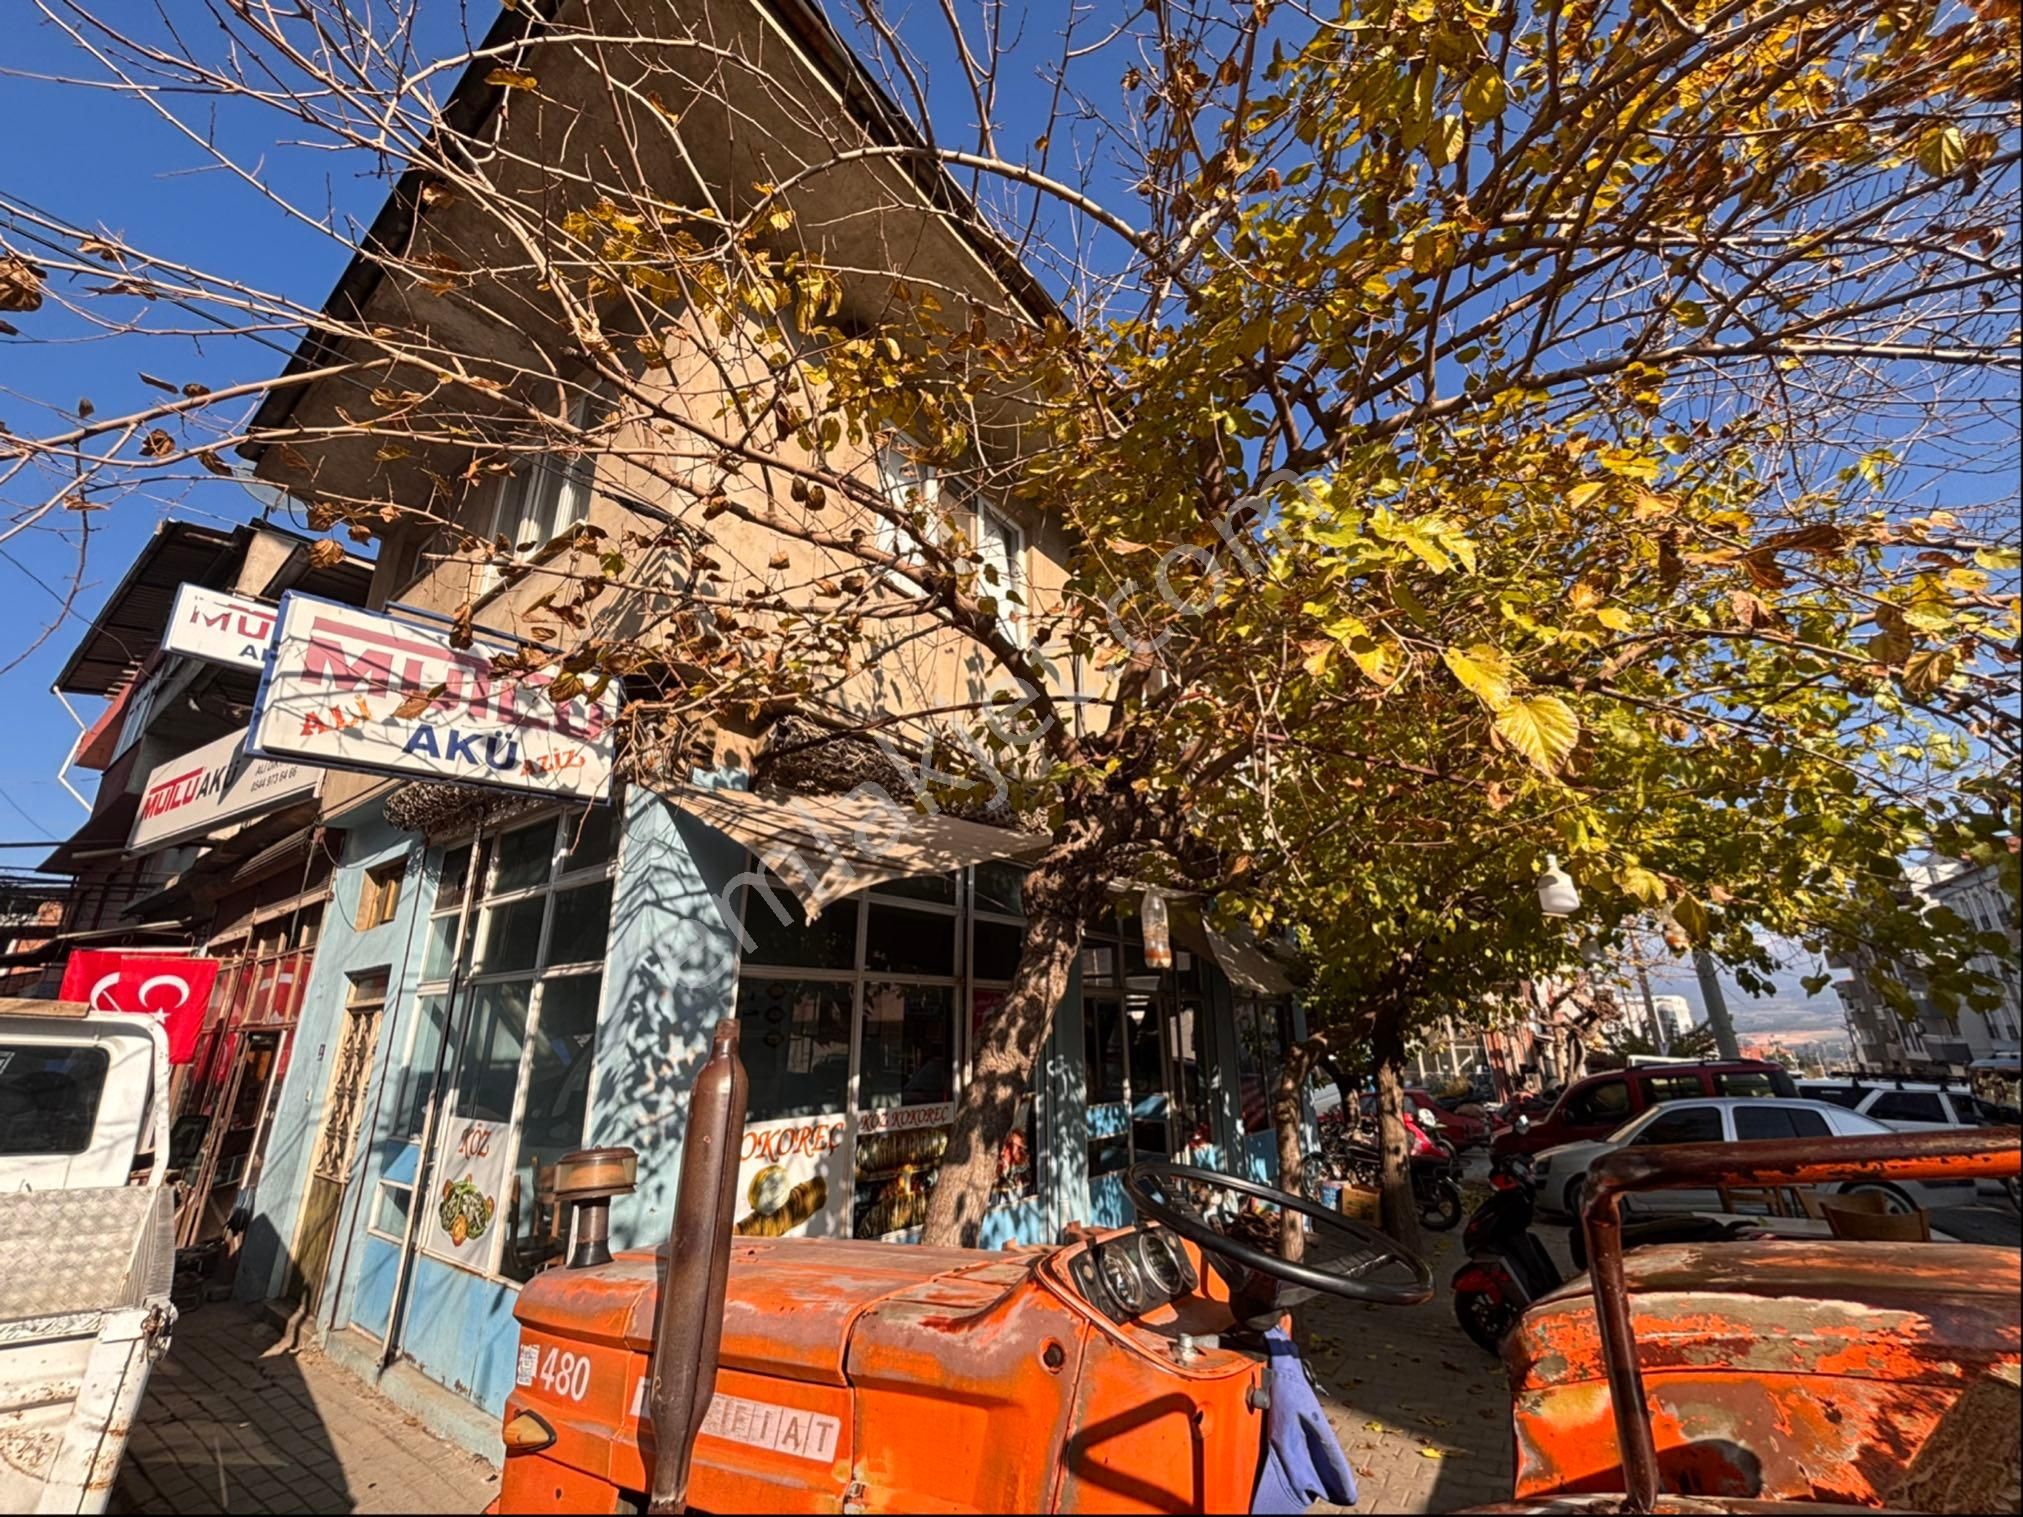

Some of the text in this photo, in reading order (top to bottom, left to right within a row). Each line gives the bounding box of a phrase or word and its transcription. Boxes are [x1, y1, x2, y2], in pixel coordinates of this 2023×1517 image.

[301, 616, 604, 740] MUTLU
[402, 723, 519, 770] AKÜ
[458, 1122, 492, 1160] KÖZ
[739, 1121, 844, 1163] OKOREÇ
[540, 1347, 591, 1401] 480
[731, 1404, 834, 1453] FIAT
